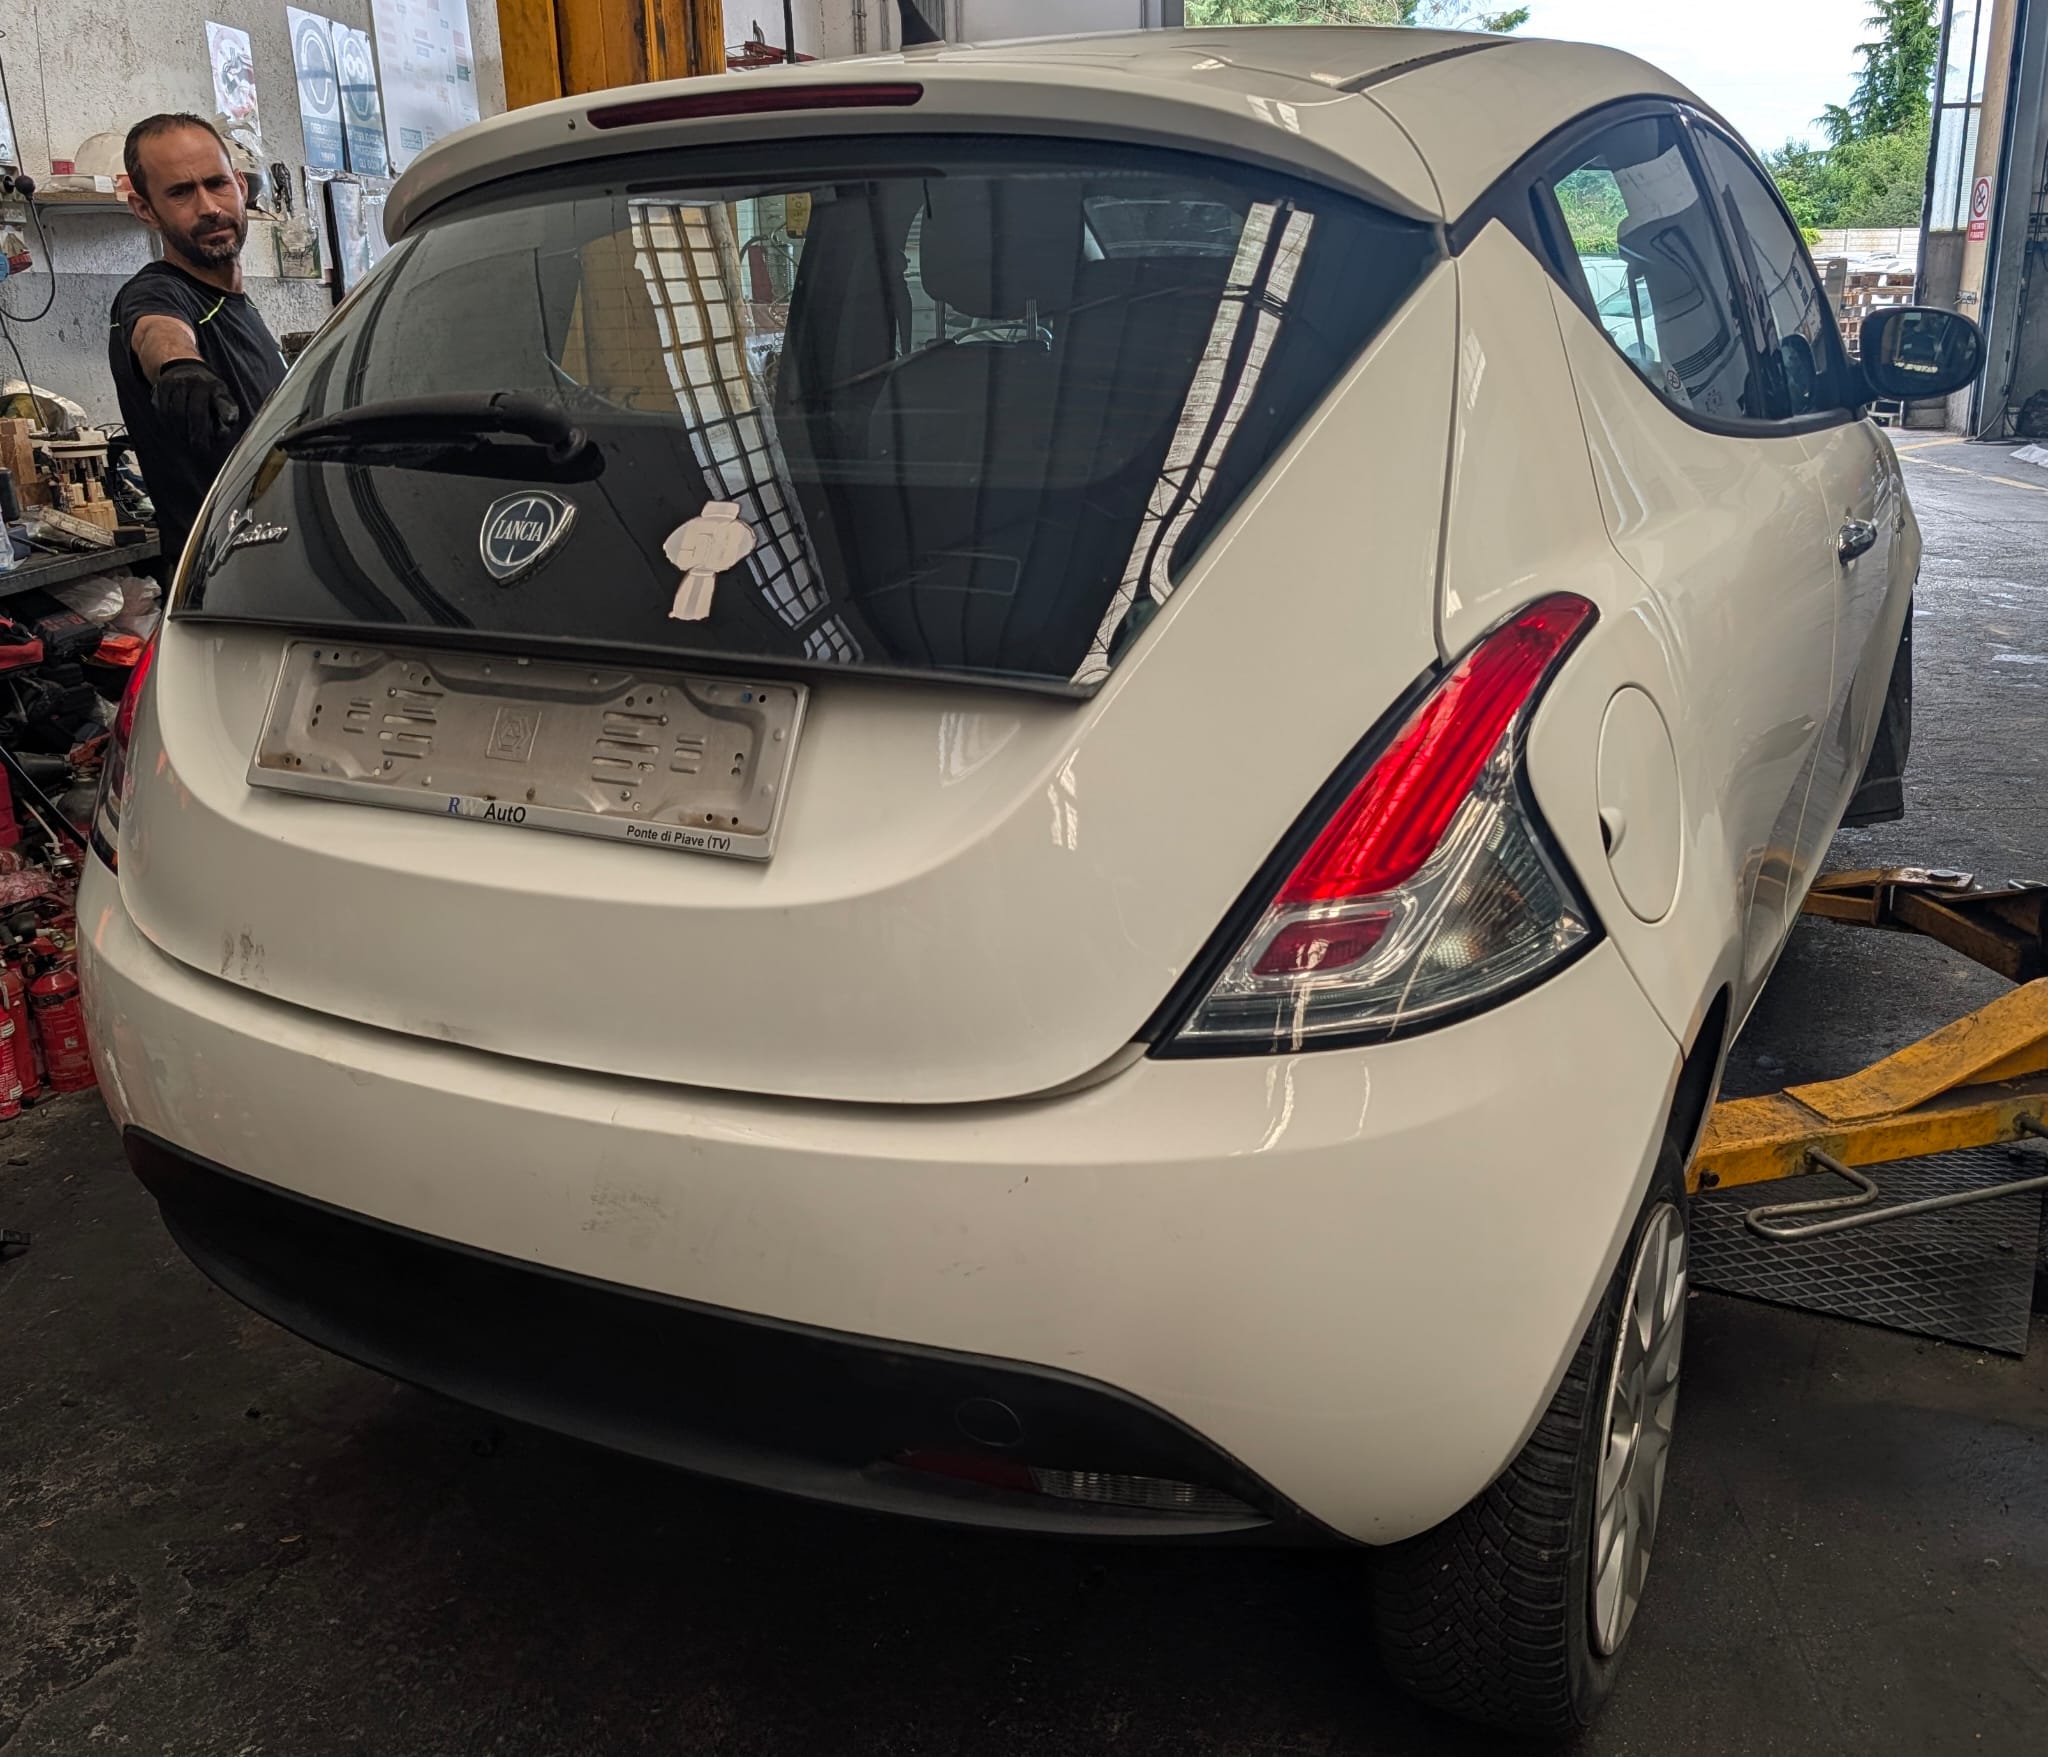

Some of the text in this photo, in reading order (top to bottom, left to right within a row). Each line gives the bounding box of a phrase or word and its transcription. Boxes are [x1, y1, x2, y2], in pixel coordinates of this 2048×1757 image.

[493, 519, 545, 542] LANCIA
[626, 824, 731, 852] Ponte di Piave (TV)
